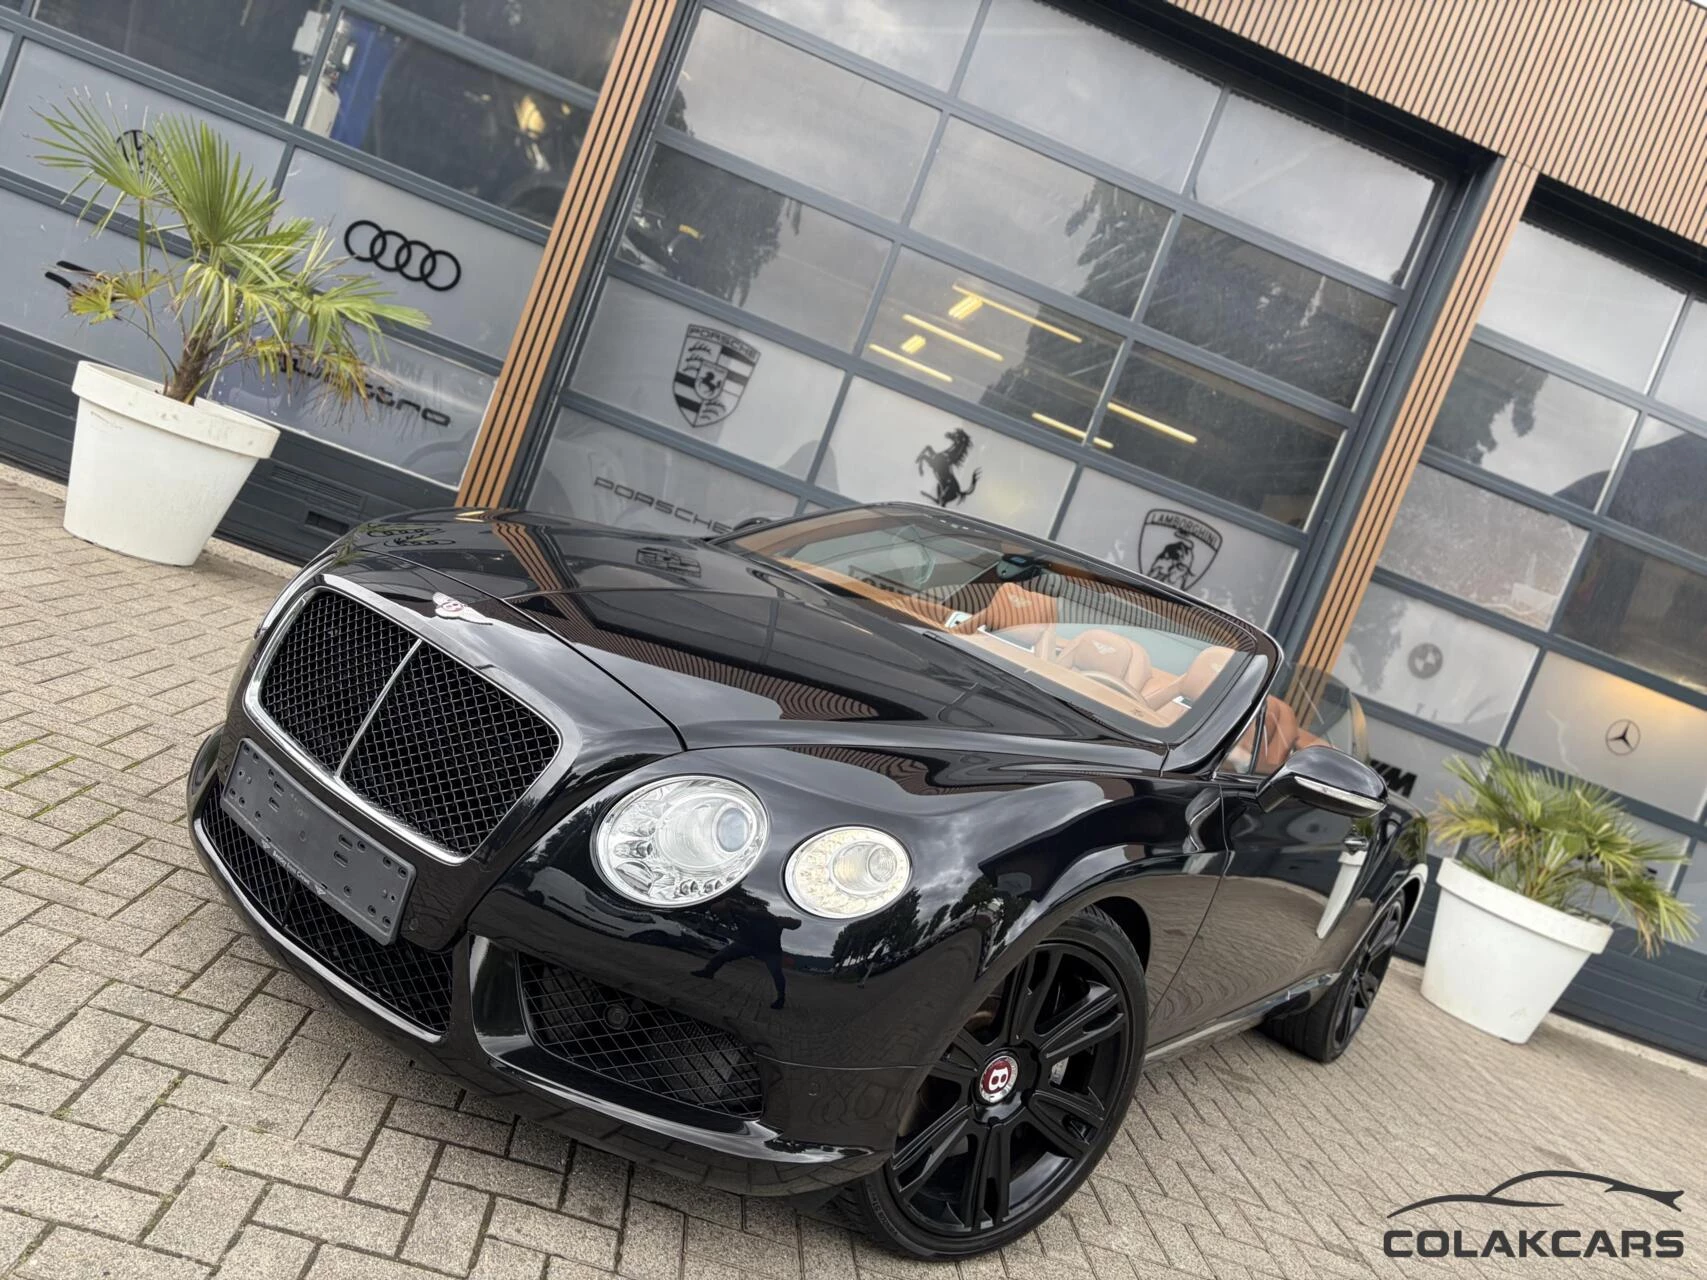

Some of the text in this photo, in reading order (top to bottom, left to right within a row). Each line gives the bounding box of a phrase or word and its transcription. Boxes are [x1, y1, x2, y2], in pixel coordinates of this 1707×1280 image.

[689, 328, 759, 361] PORSCHE
[594, 476, 733, 534] PORSCHE
[1151, 513, 1217, 549] LAMBORGHINI
[988, 1066, 1009, 1091] B
